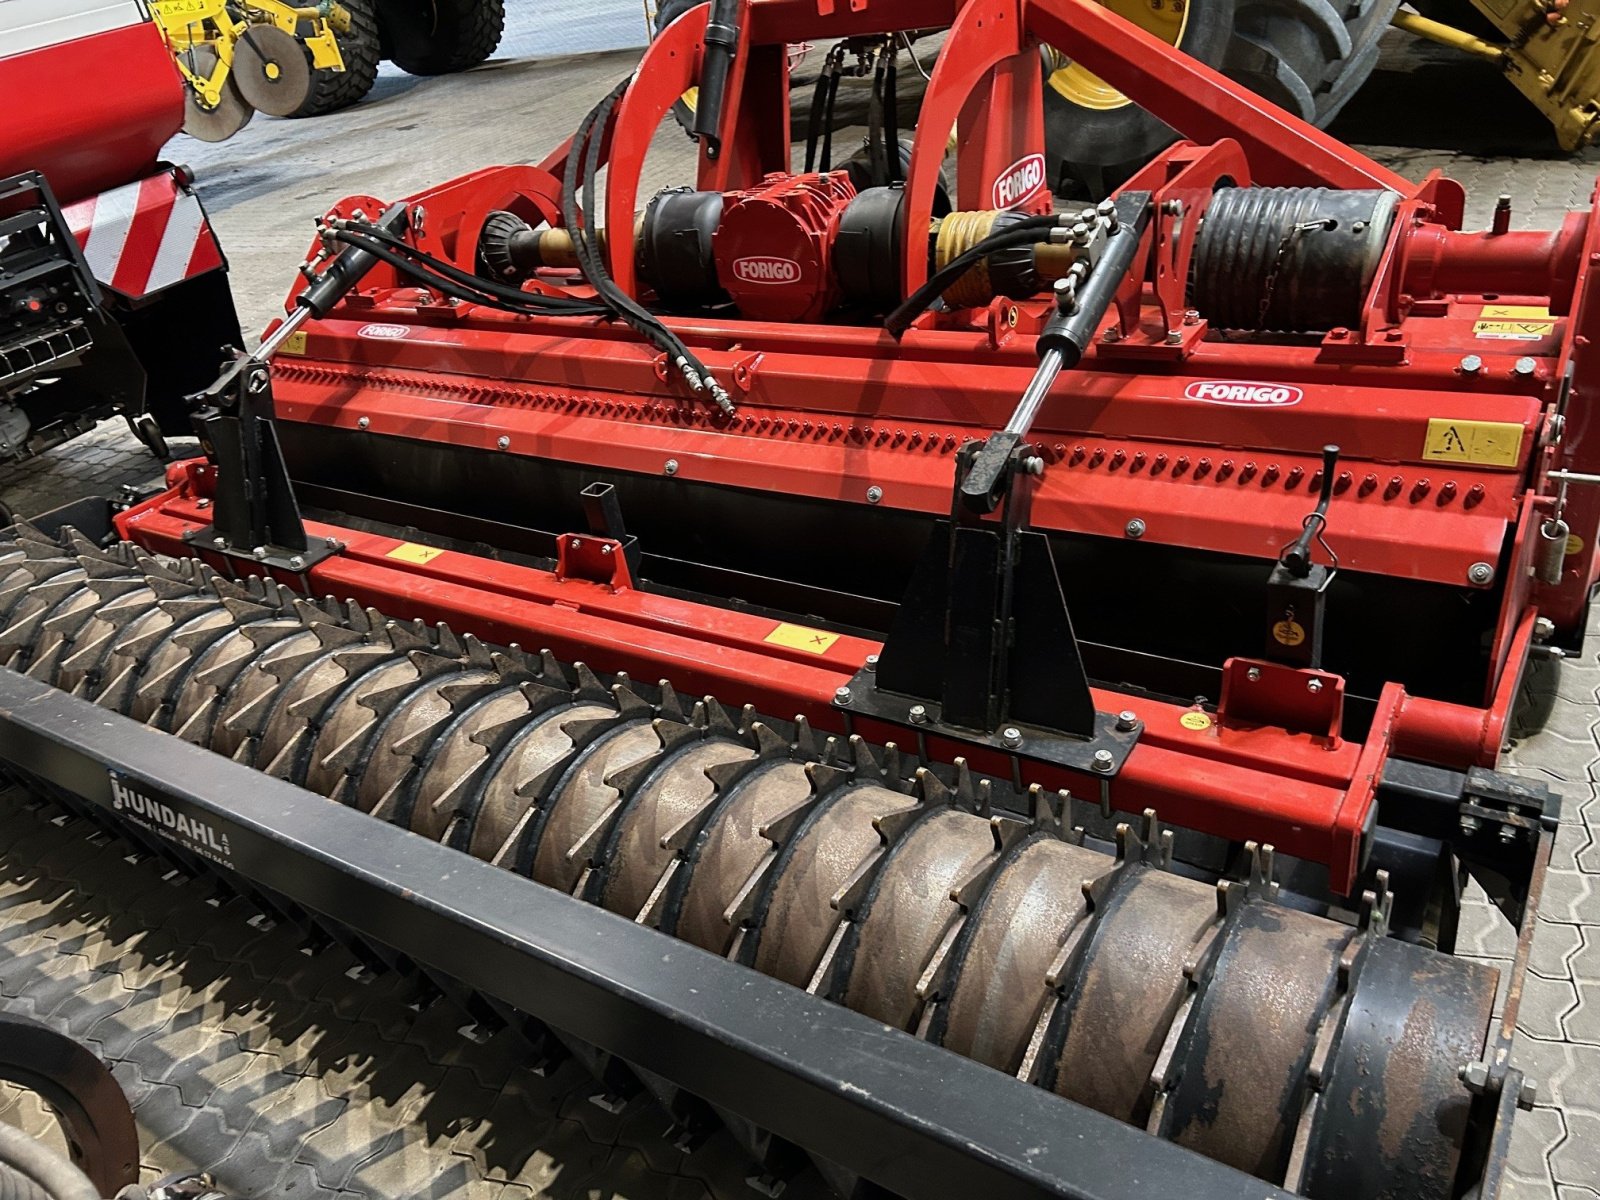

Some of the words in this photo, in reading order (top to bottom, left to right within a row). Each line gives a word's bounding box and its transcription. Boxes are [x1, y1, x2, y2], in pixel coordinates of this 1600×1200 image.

[998, 159, 1041, 208] FORIGO
[739, 261, 794, 280] FORIGO
[1195, 383, 1290, 403] FORIGO
